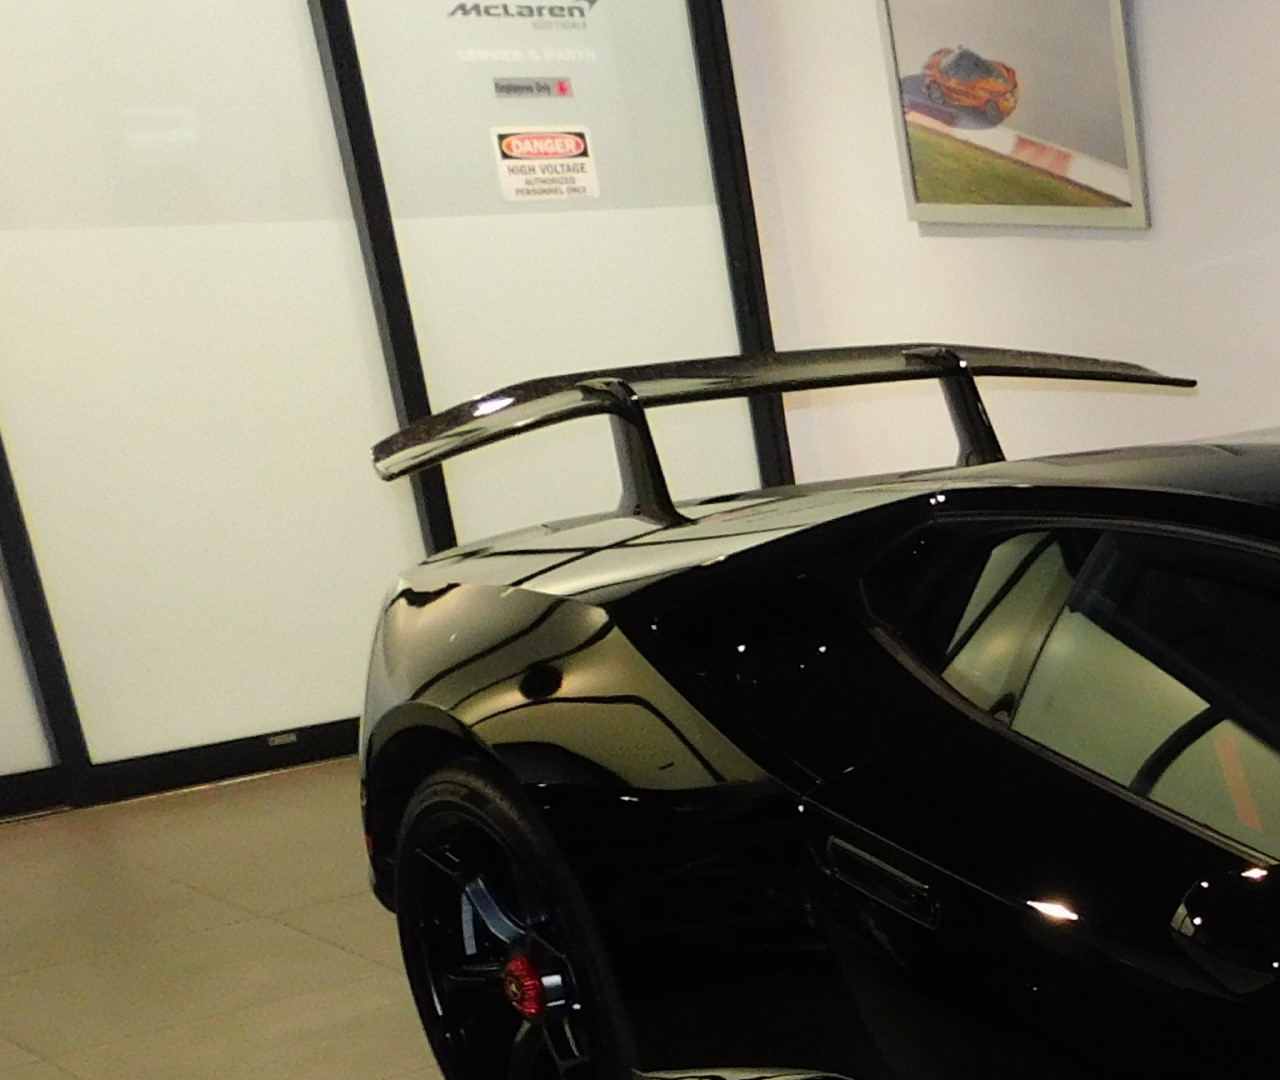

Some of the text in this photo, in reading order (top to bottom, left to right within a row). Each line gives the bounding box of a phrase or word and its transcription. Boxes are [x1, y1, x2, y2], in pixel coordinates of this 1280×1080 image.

[446, 3, 586, 18] McLaren
[511, 138, 578, 153] DANGER
[507, 163, 587, 176] HIGH VOLTAGE
[515, 186, 587, 197] PERSONNEL ONLY
